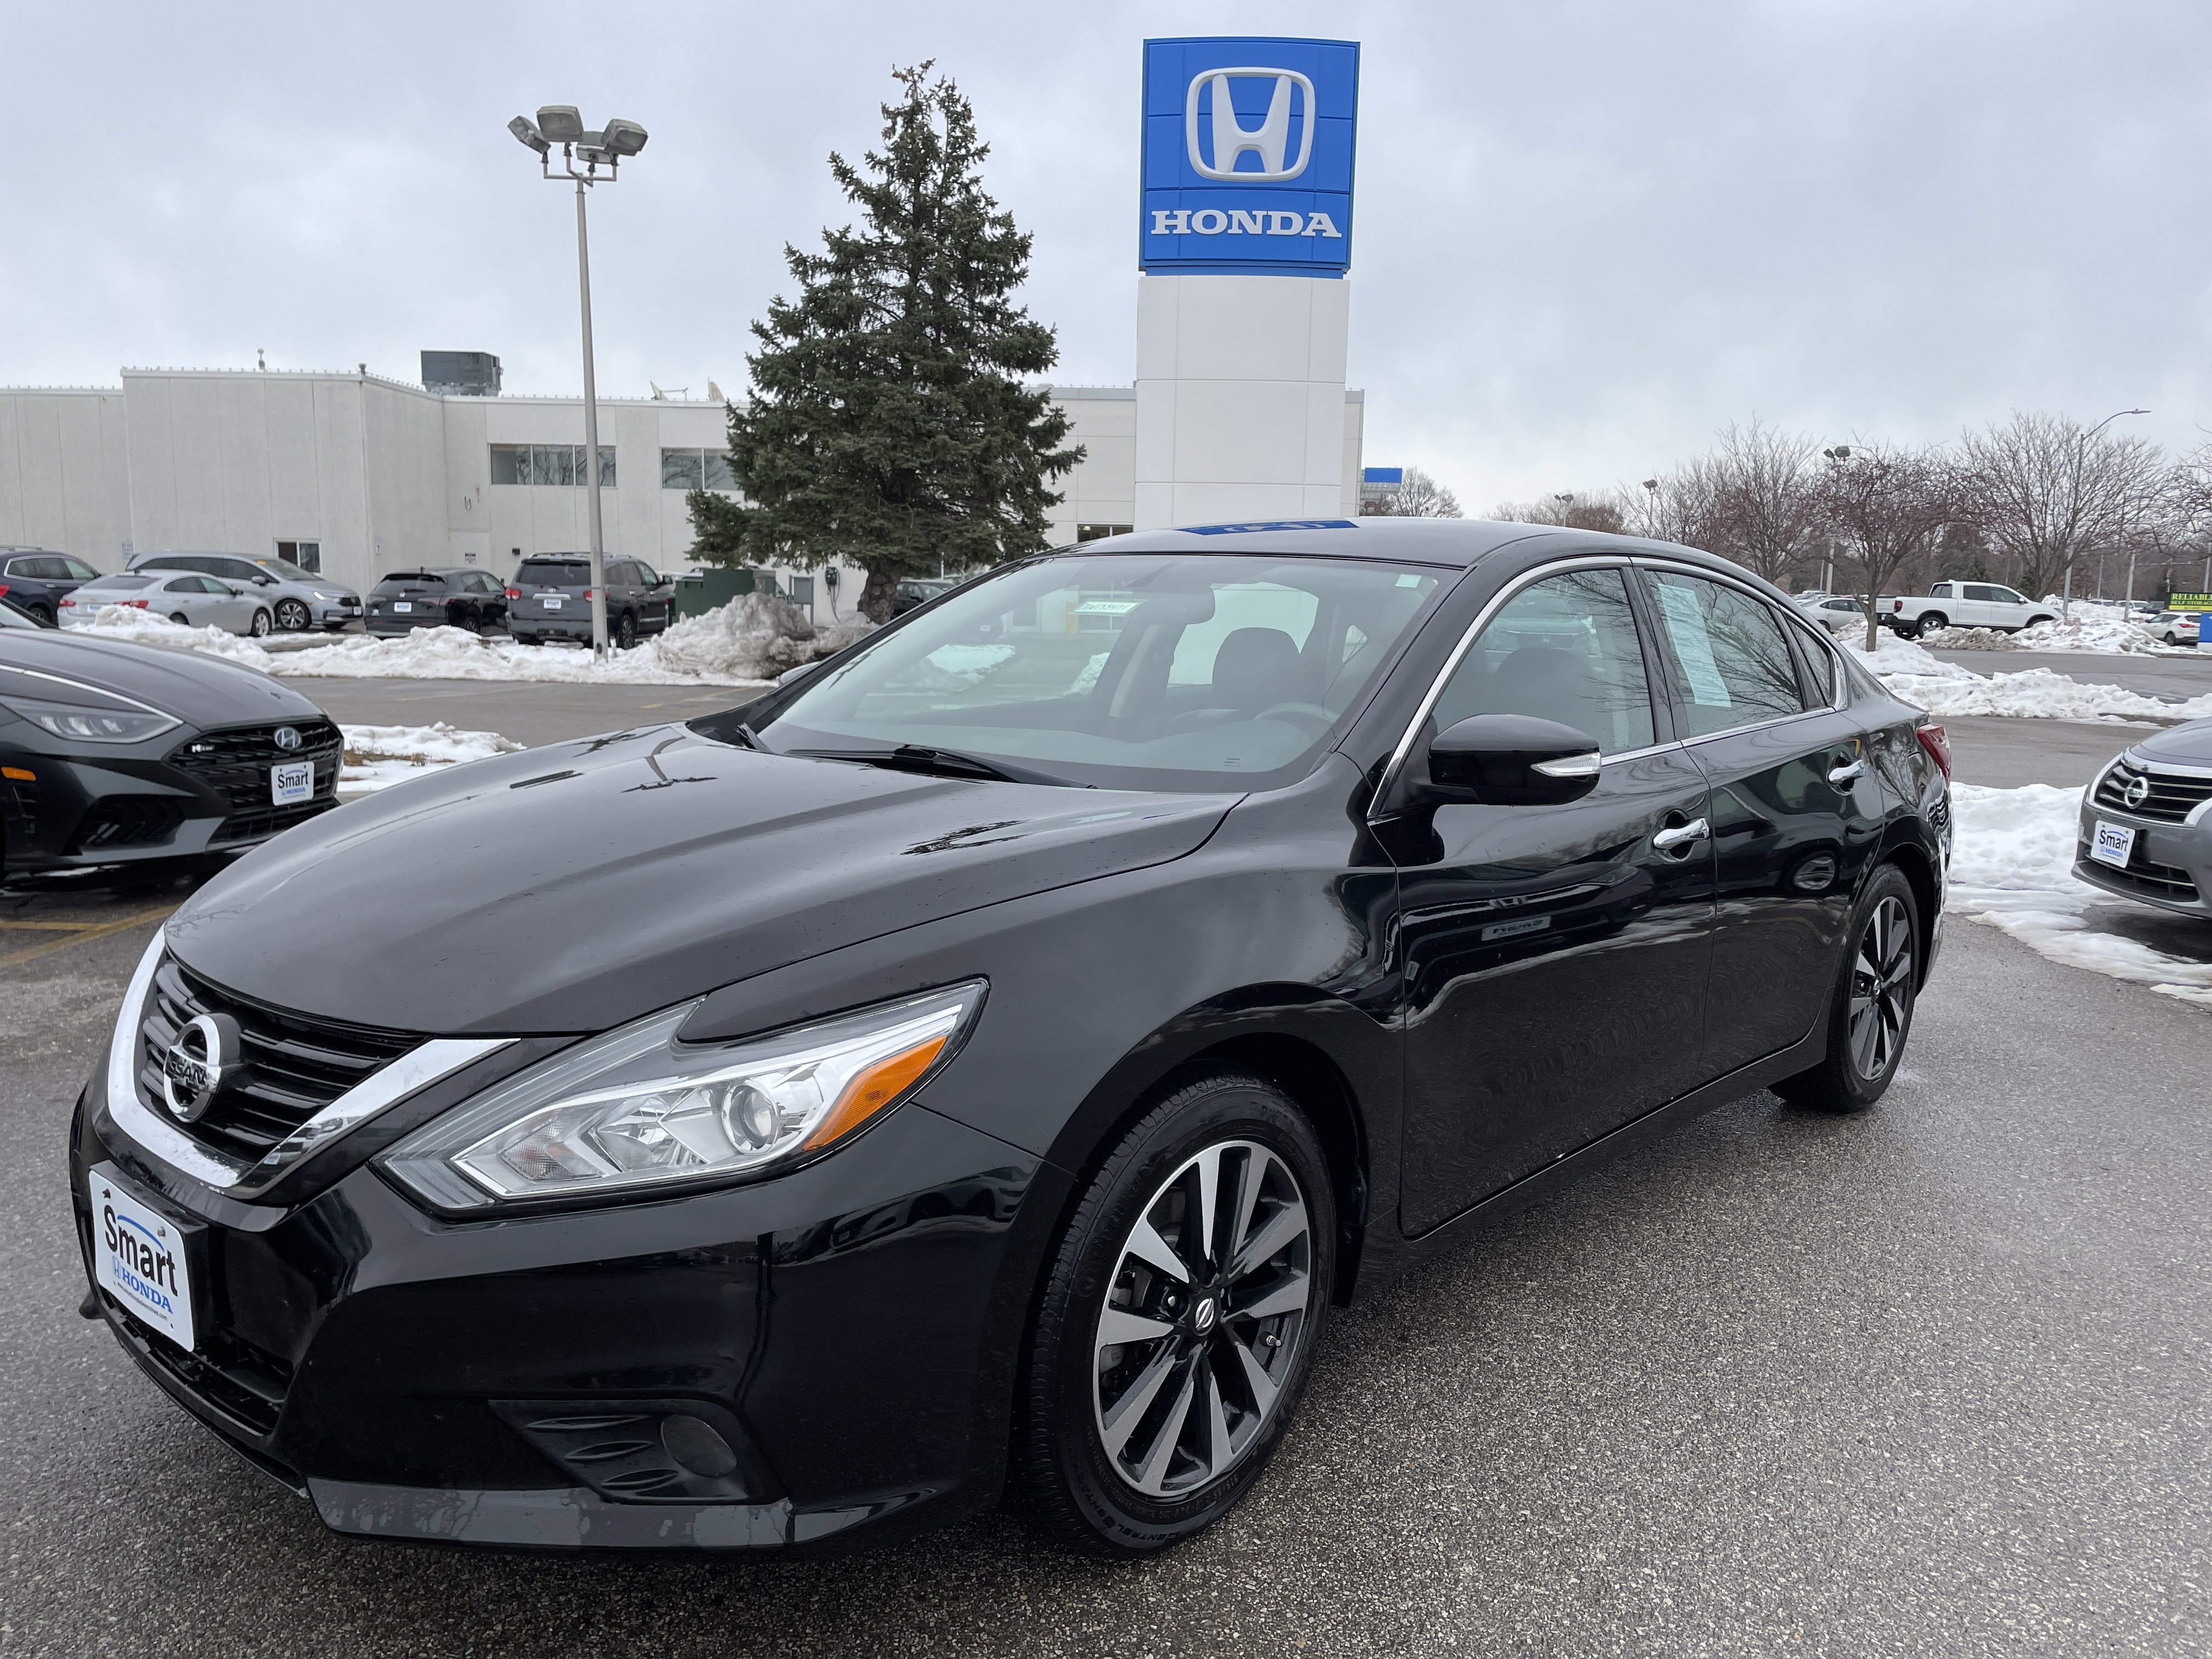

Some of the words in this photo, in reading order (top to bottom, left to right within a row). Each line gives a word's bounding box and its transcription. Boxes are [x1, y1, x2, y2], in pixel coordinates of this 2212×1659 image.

[1151, 210, 1342, 238] HONDA
[278, 771, 308, 788] Smart
[2100, 830, 2129, 851] Smart
[104, 1205, 178, 1297] Smart
[122, 1267, 173, 1314] HONDA
